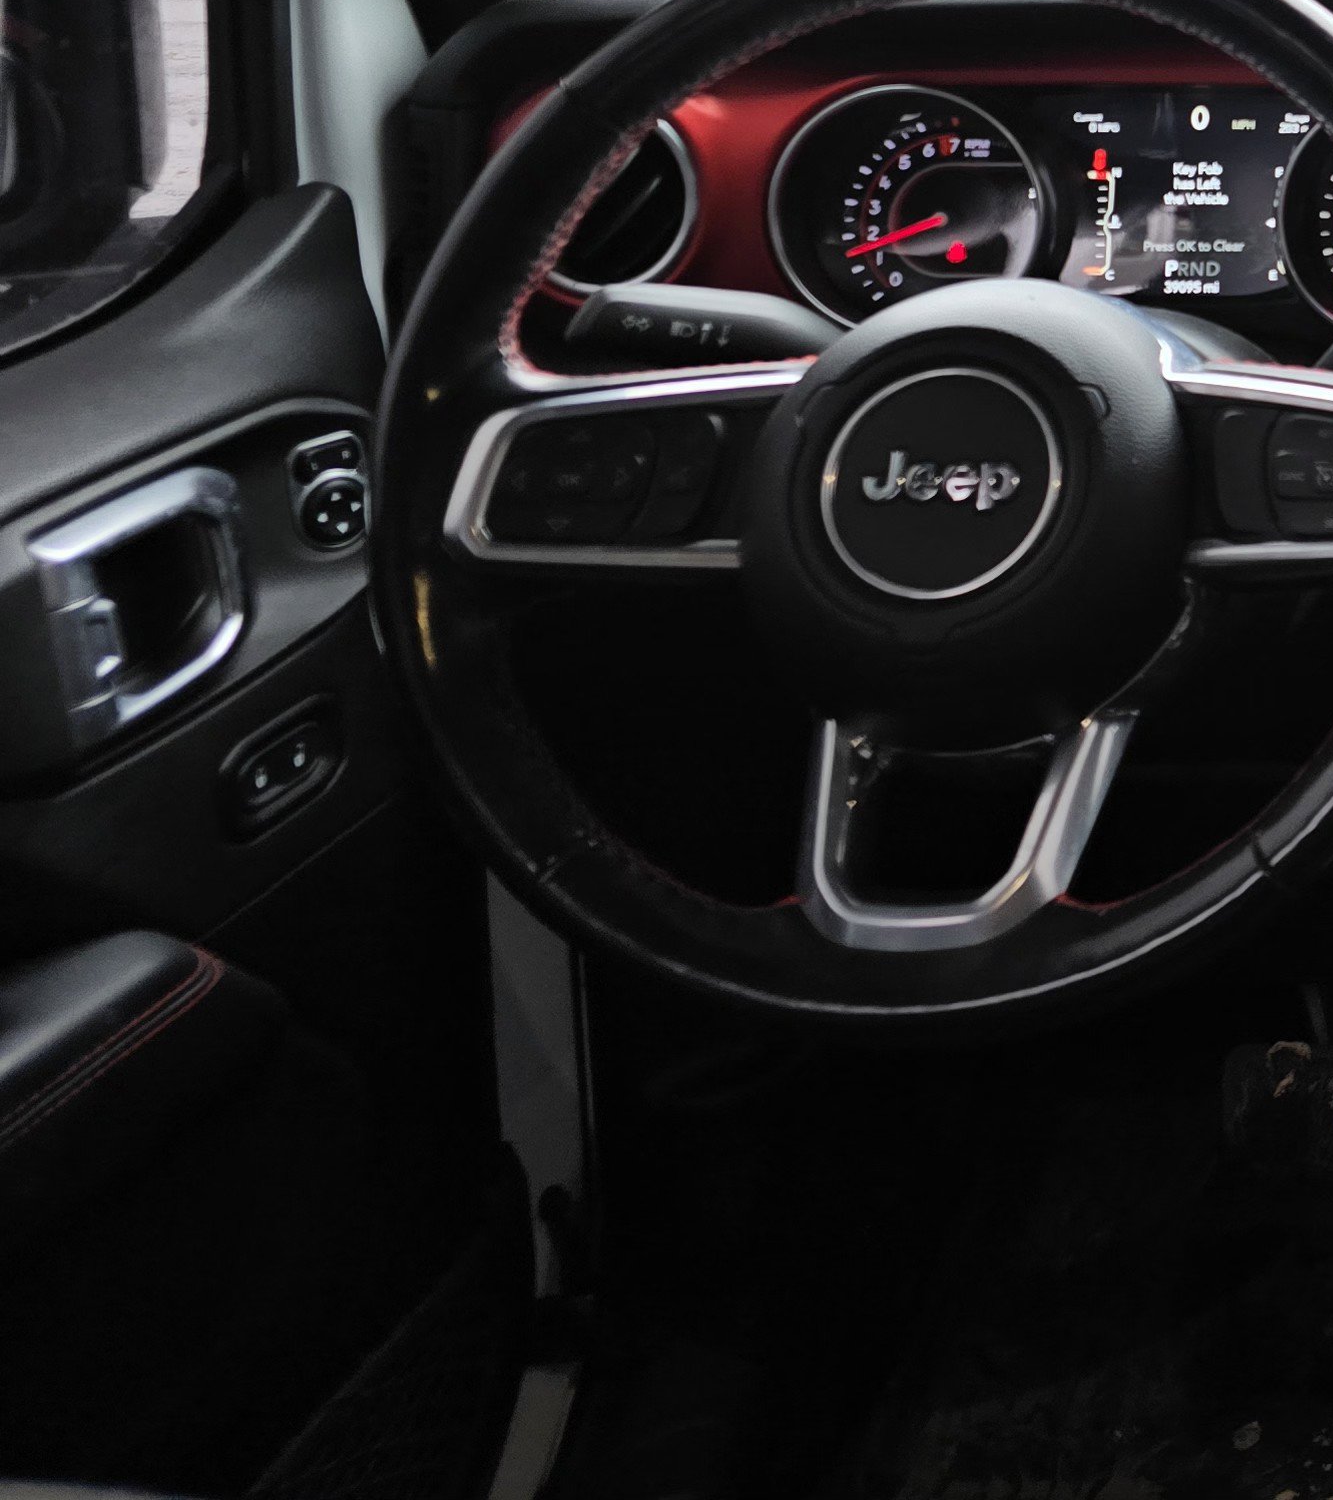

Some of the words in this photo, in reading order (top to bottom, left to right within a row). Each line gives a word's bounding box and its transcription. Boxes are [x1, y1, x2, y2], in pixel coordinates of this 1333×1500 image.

[1190, 104, 1211, 131] 0
[922, 143, 936, 158] 6
[898, 153, 912, 171] 5
[1173, 162, 1198, 177] Key
[1198, 161, 1224, 176] Fob
[1173, 177, 1196, 190] has
[1196, 177, 1222, 190] Left
[1163, 191, 1185, 205] the
[1185, 191, 1230, 205] Vehicle
[868, 199, 882, 216] 3
[1142, 240, 1175, 253] Press
[1176, 240, 1198, 253] OK
[1198, 240, 1212, 253] to
[1213, 240, 1245, 253] Clear
[1105, 269, 1115, 282] C
[1163, 280, 1203, 295] 39095
[1203, 280, 1220, 295] mi
[862, 450, 1020, 511] Jeep
